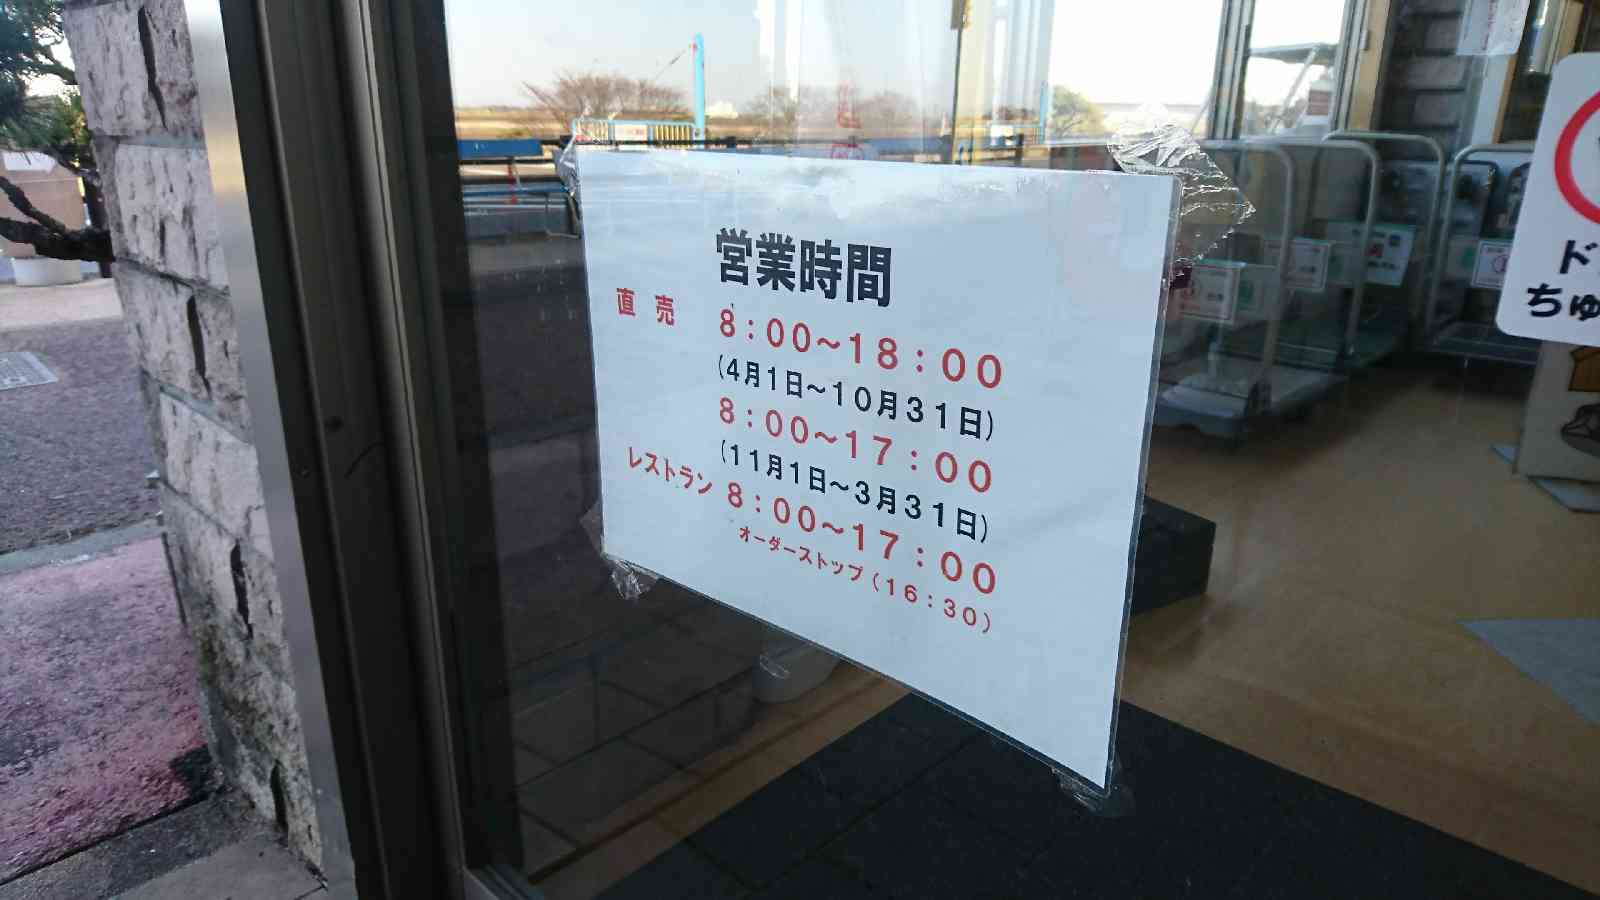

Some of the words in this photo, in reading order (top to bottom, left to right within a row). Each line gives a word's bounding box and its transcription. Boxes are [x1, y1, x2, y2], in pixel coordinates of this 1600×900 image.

[715, 227, 892, 308] 営業時間
[719, 308, 1002, 389] 8:00～18:00
[718, 353, 994, 443] (4月1日～10月31日)
[719, 396, 993, 494] 8:00～17:00
[628, 446, 713, 495] レストラン
[727, 481, 996, 595] 8:00～17:00
[721, 439, 988, 544] (11月1日～3月31日)
